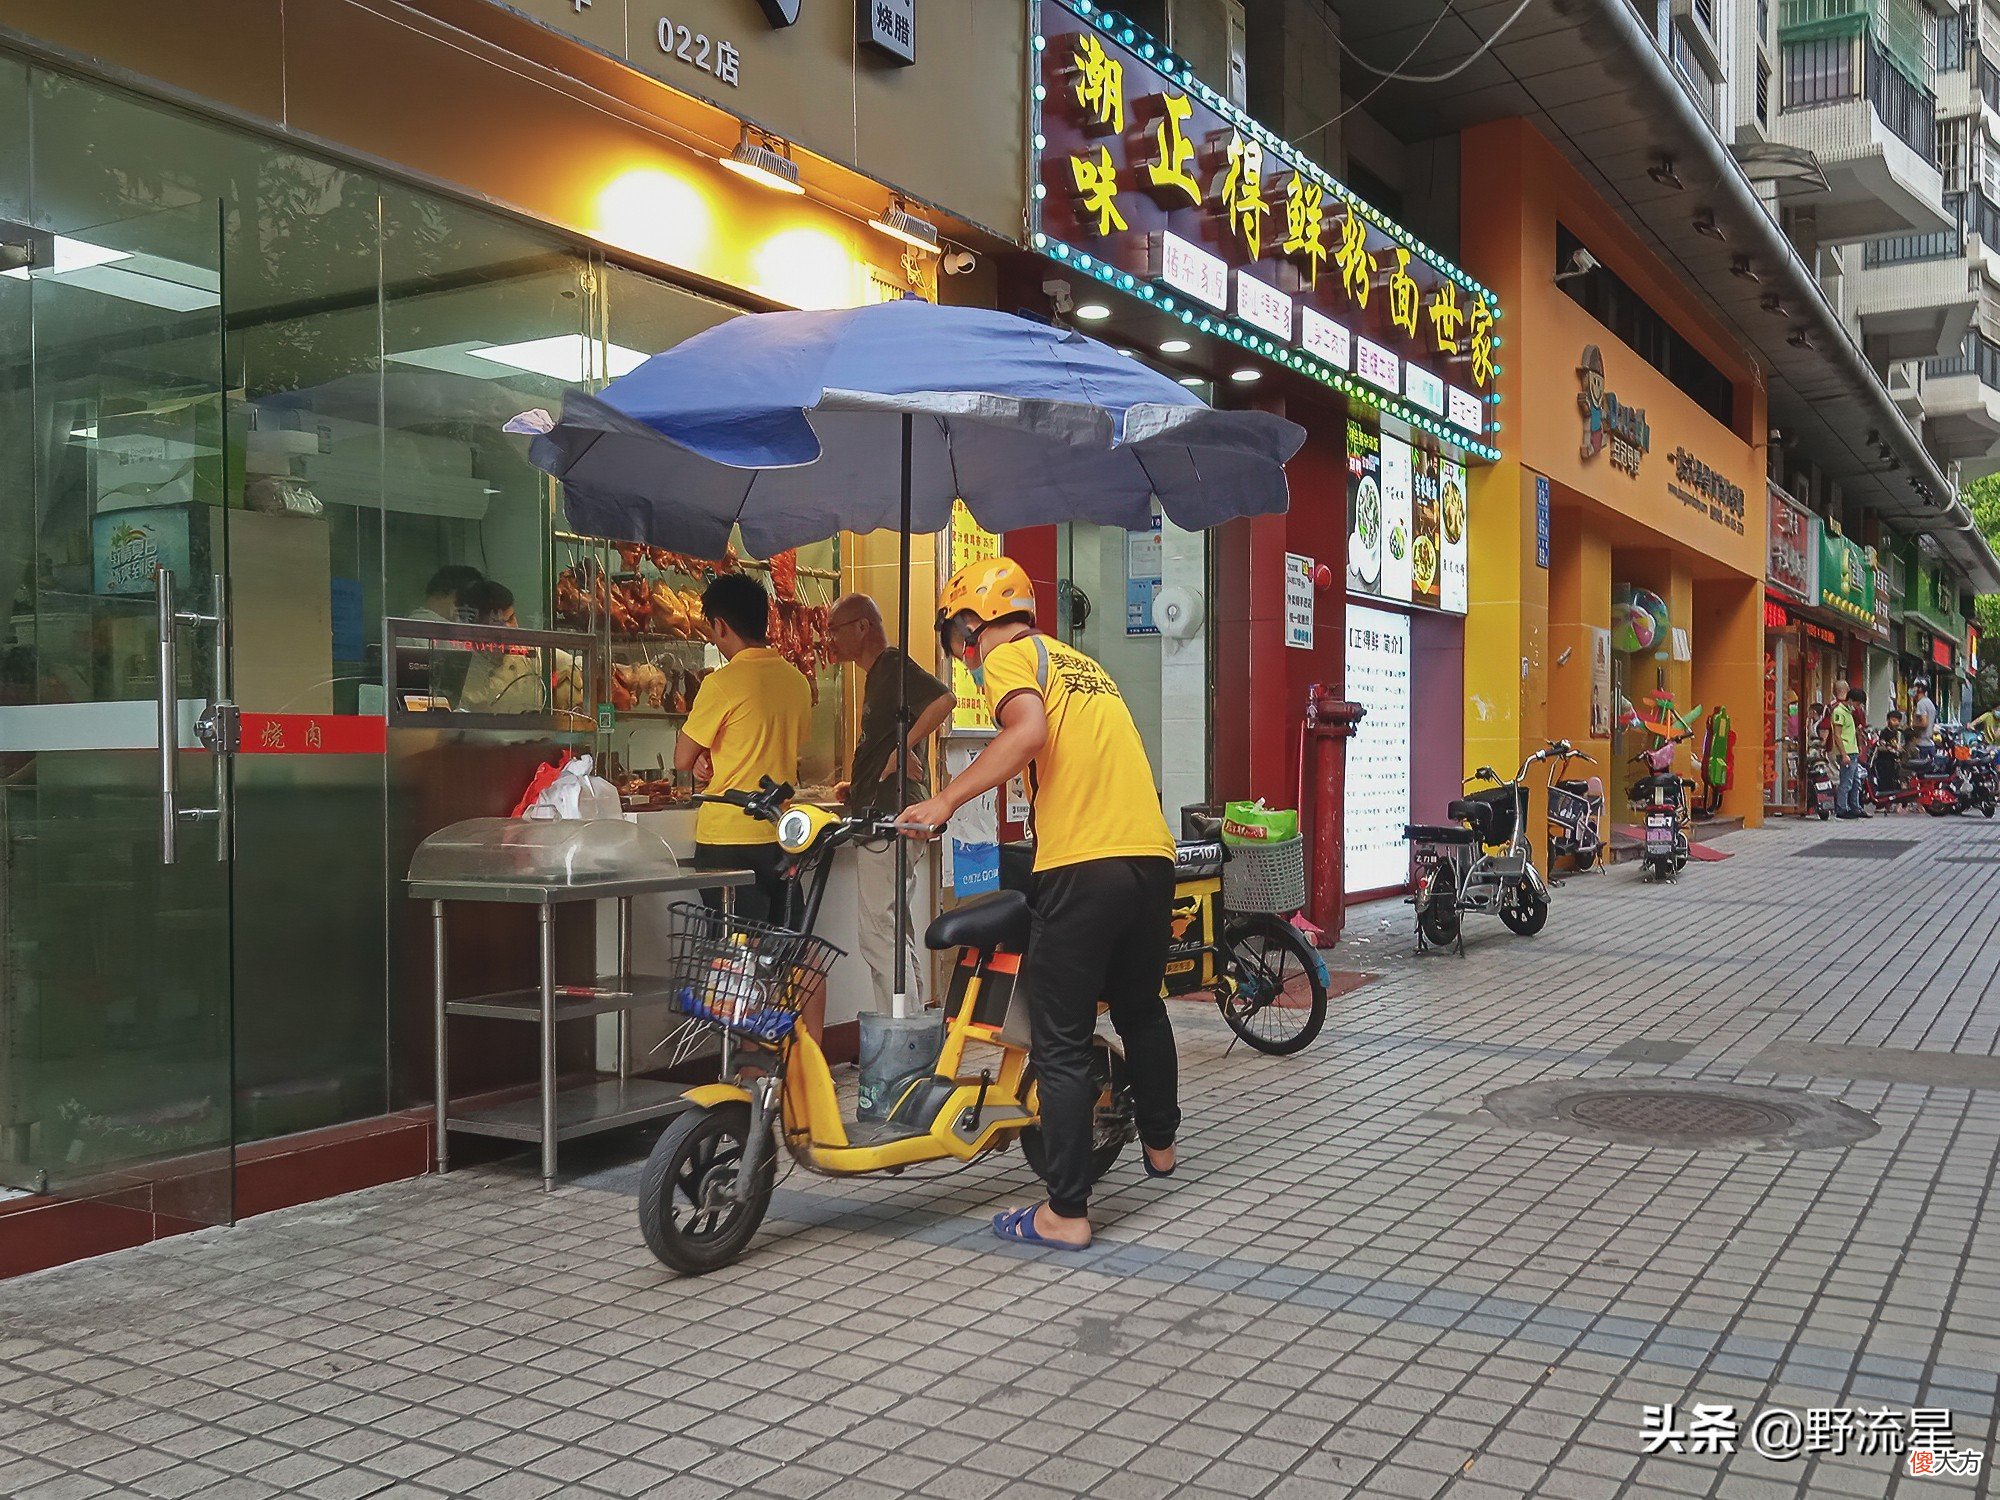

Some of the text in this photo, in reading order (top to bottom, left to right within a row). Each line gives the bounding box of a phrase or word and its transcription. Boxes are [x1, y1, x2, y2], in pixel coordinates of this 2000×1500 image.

[657, 16, 740, 87] 022店
[875, 2, 912, 48] 烧腊
[1070, 33, 1129, 236] 潮味
[1148, 92, 1495, 387] 正得鲜粉面世家
